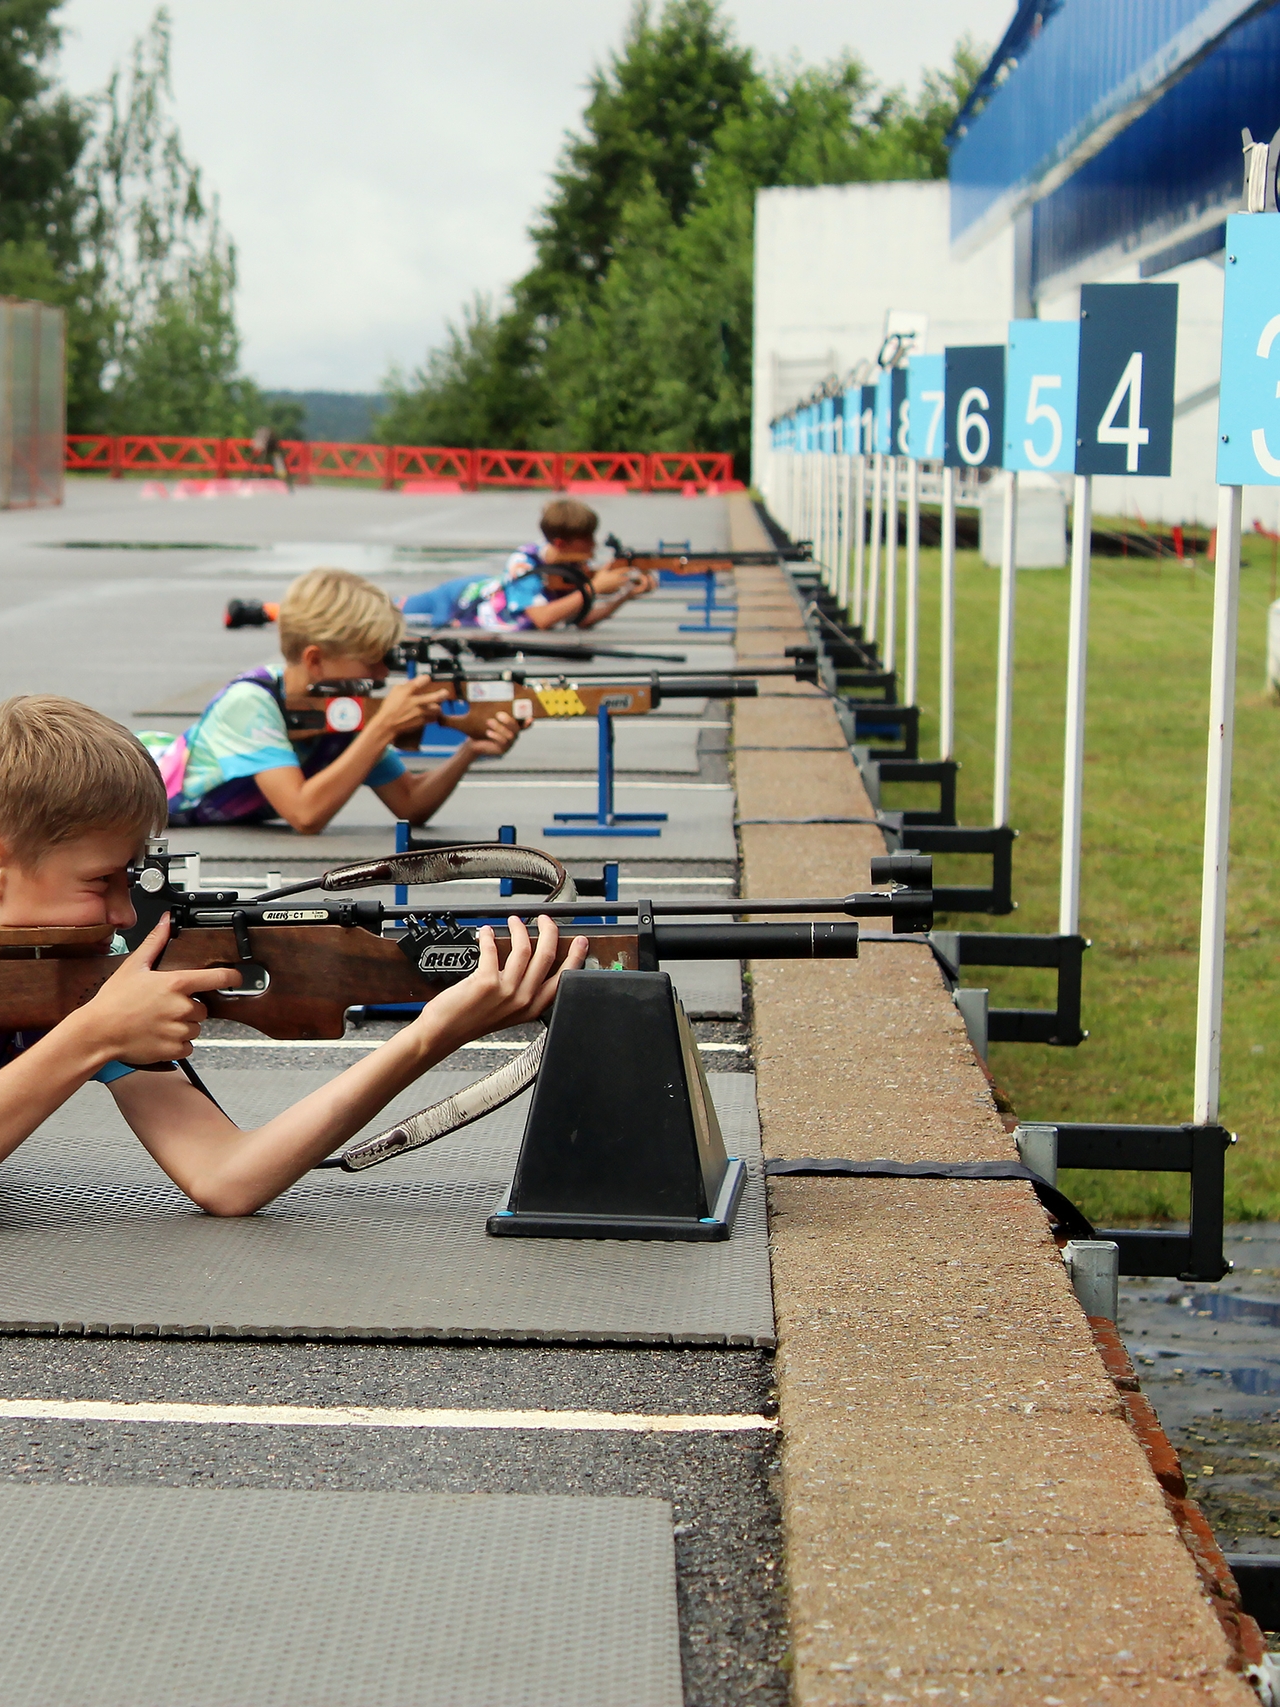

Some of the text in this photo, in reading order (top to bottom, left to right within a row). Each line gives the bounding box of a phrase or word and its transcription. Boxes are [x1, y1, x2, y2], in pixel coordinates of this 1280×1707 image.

[921, 390, 945, 457] 7
[956, 387, 990, 466] 6
[1023, 375, 1063, 468] 5
[1097, 351, 1149, 472] 4
